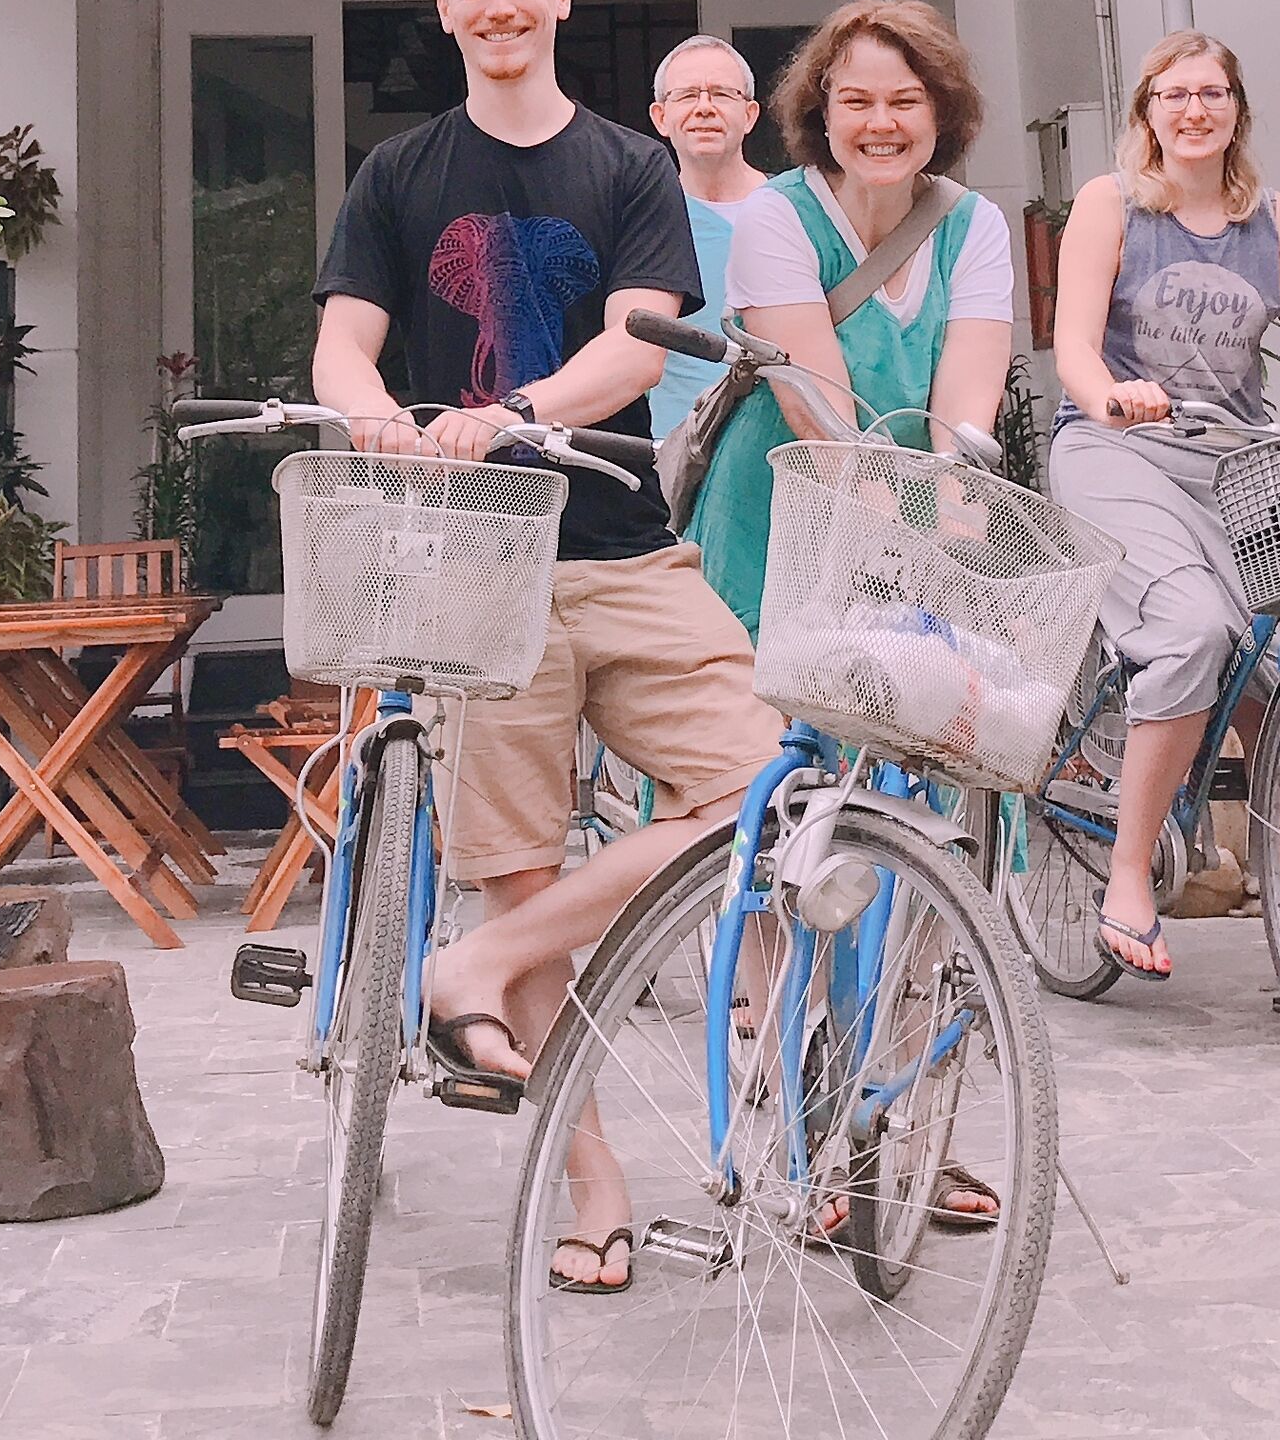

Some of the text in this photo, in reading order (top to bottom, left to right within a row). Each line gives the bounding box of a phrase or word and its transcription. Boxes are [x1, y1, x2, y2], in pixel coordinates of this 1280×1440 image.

[1155, 271, 1254, 329] Enjoy
[1136, 318, 1164, 339] the
[1171, 325, 1207, 345] little
